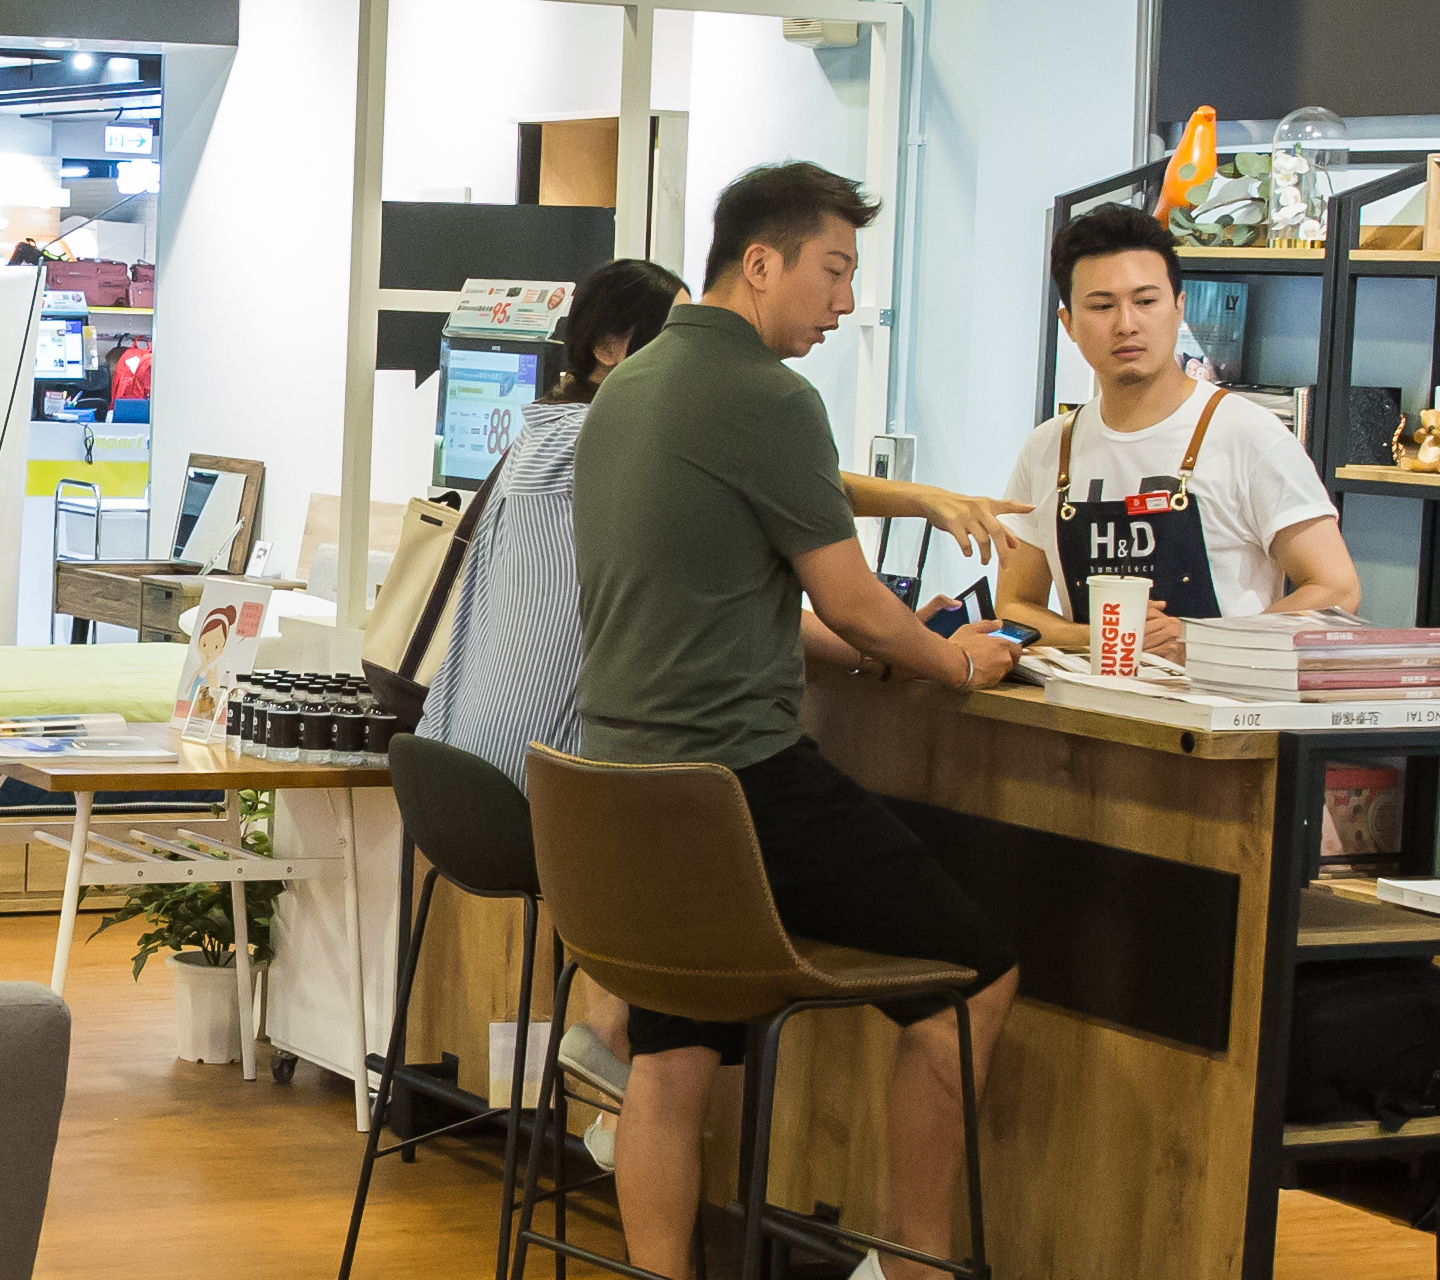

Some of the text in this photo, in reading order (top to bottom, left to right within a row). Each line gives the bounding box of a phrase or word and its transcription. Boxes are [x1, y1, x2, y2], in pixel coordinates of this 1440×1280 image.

[487, 408, 511, 455] 88
[1090, 521, 1155, 559] H&D
[1100, 602, 1121, 677] BURGER
[1233, 713, 1261, 727] 2019
[1406, 709, 1422, 722] TAI
